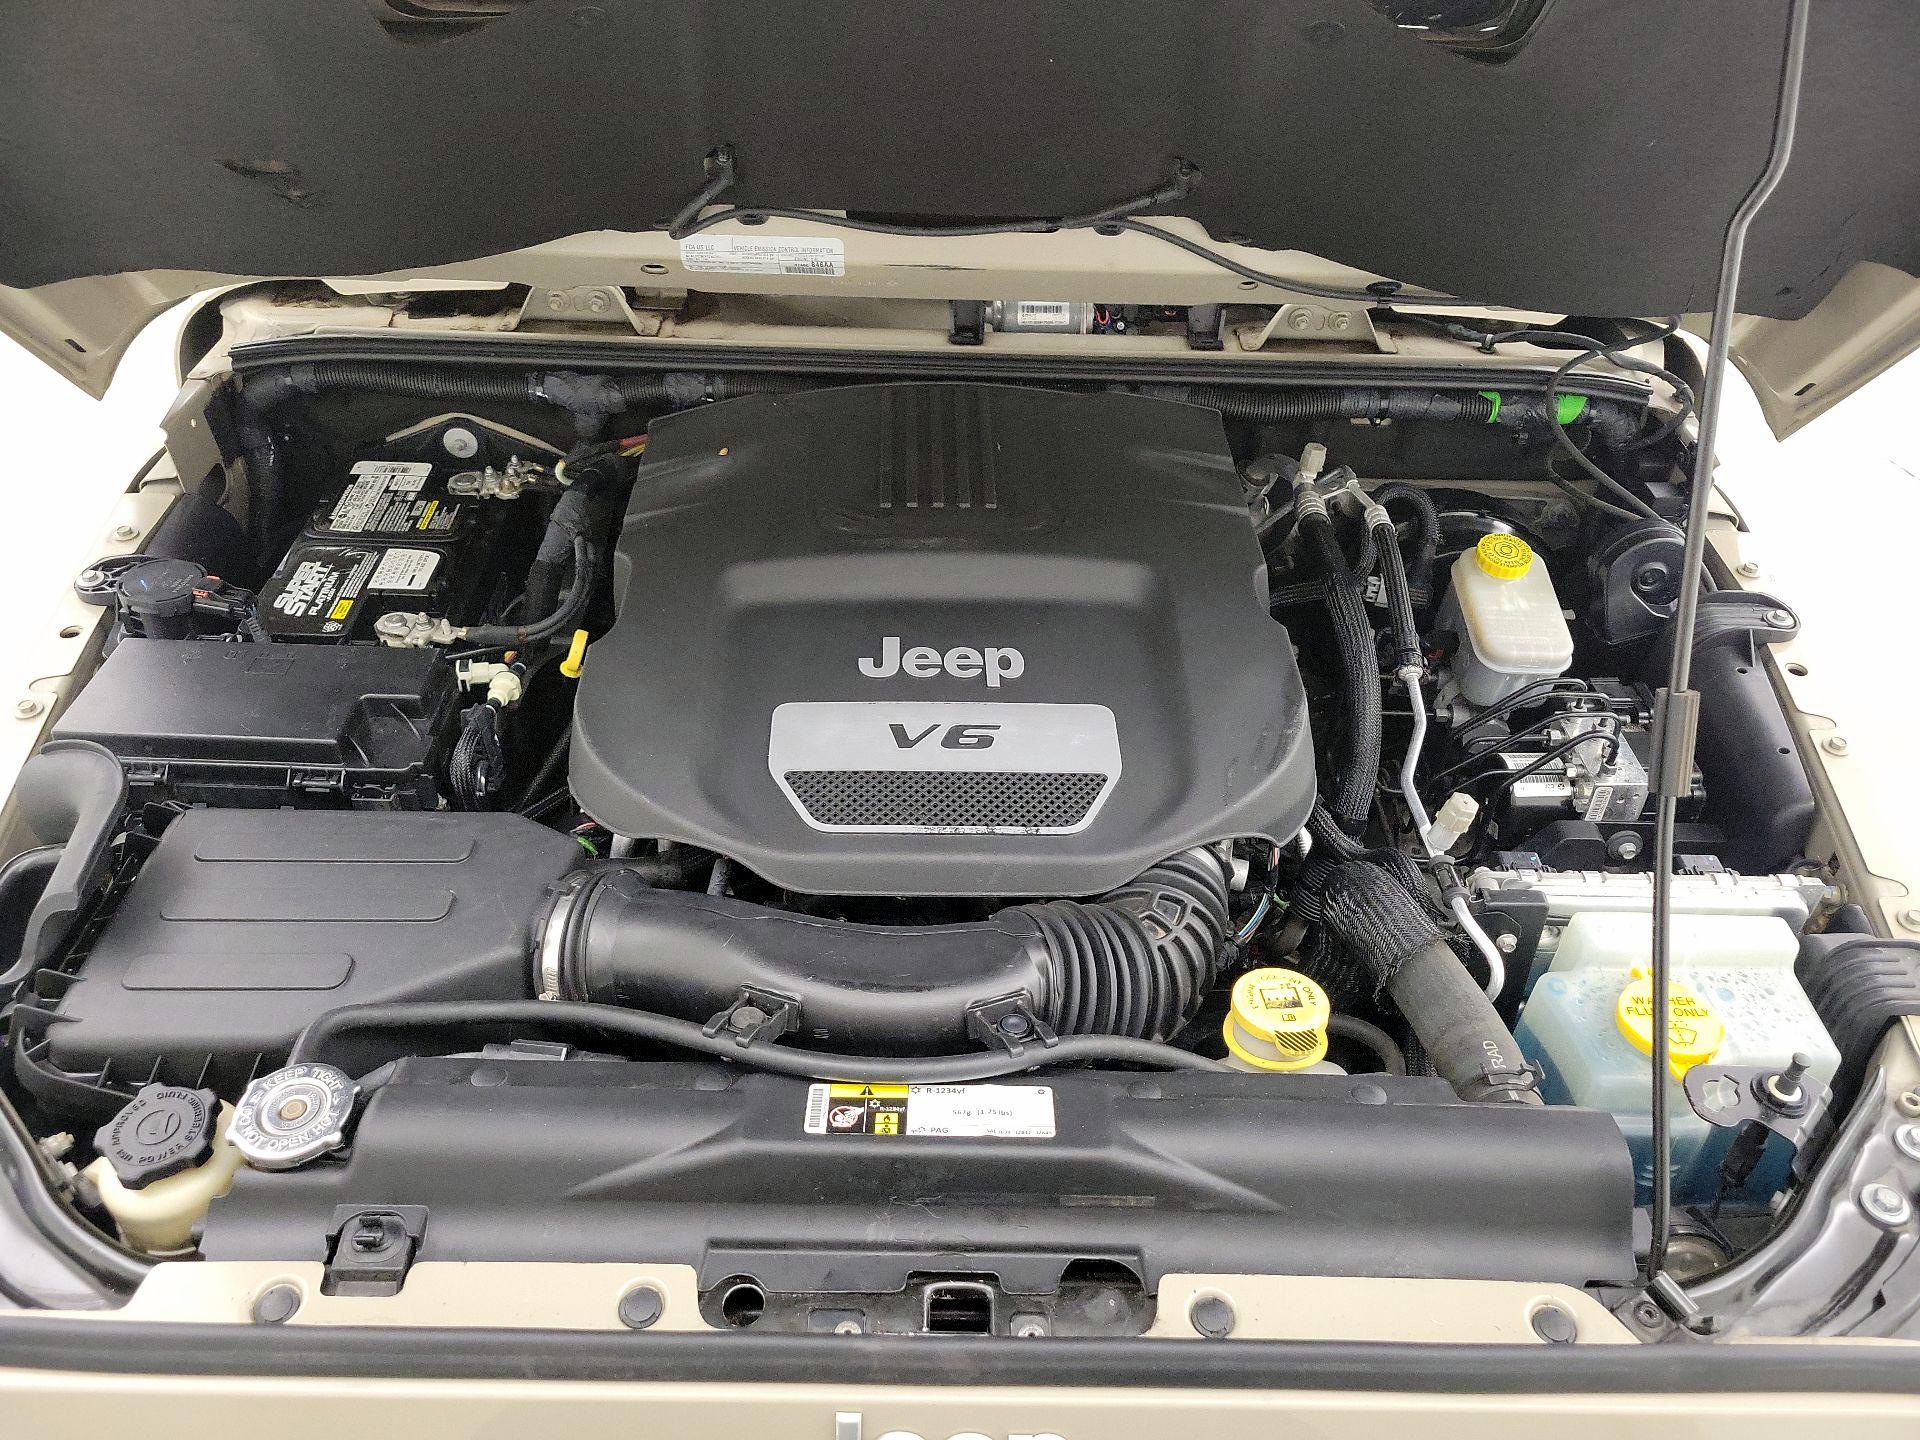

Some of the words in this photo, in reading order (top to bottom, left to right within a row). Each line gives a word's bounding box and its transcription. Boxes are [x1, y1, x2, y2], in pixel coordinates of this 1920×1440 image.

[273, 561, 318, 609] SUPER
[283, 561, 329, 617] START
[307, 571, 340, 616] PLATINUM
[858, 636, 1025, 688] Jeep
[888, 723, 1002, 750] V6
[1302, 986, 1318, 1007] ONLY
[1631, 996, 1696, 1006] WAHER
[1673, 1007, 1709, 1018] ONLY
[1483, 1040, 1507, 1069] RAD
[263, 1066, 308, 1090] KEEP
[312, 1066, 345, 1091] TIGHT
[926, 1087, 967, 1095] R-1234yf
[156, 1090, 188, 1101] FLUID
[184, 1097, 203, 1142] STEERING
[243, 1125, 266, 1147] NOT
[267, 1131, 311, 1153] OPEN
[312, 1110, 341, 1135] HOT
[138, 1143, 184, 1163] POWER
